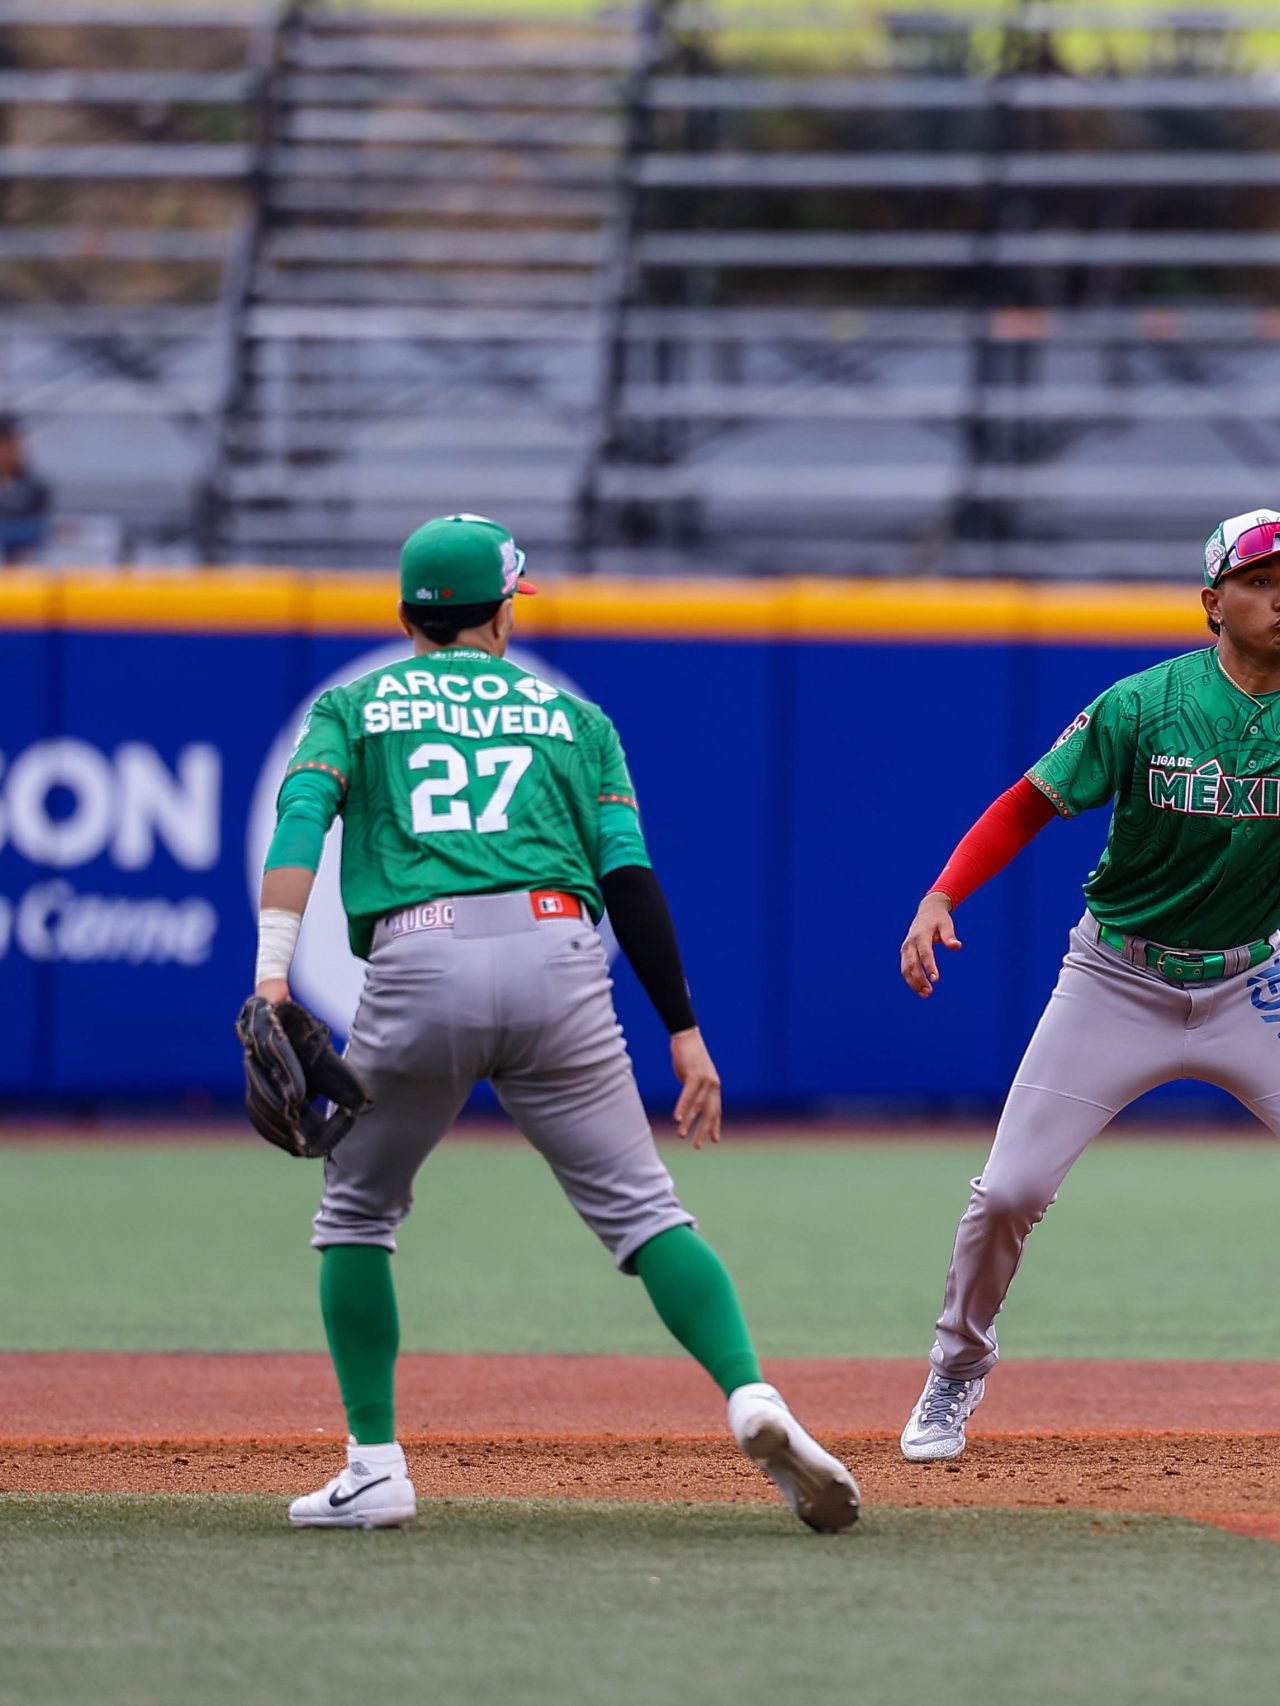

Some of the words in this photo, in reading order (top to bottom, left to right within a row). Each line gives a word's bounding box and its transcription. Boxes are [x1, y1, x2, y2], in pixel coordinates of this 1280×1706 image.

[376, 670, 509, 703] ARCO
[363, 700, 574, 742] SEPULVEDA
[1151, 754, 1176, 767] LIGA
[1177, 756, 1194, 767] DE
[0, 737, 221, 870] ON
[408, 743, 533, 834] 27
